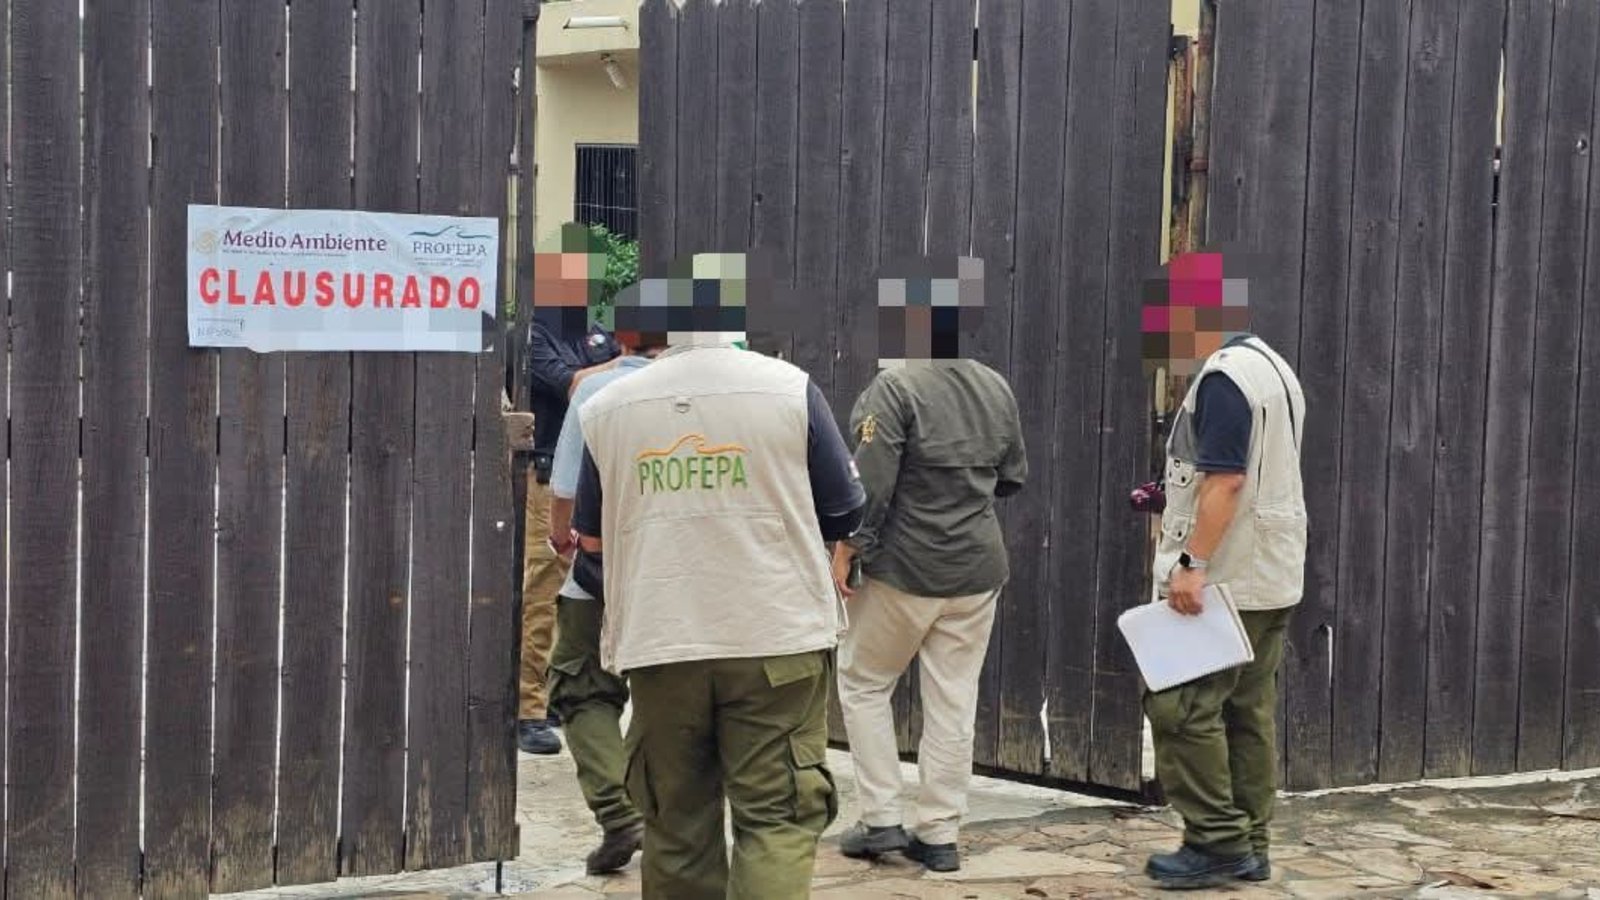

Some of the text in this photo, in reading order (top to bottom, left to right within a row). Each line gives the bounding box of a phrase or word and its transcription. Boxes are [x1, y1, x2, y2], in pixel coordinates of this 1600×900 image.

[223, 230, 387, 251] Medio Ambiente
[413, 241, 487, 256] PROFEPA
[199, 268, 481, 309] CLAUSURADO
[638, 455, 748, 495] PROFEPA
